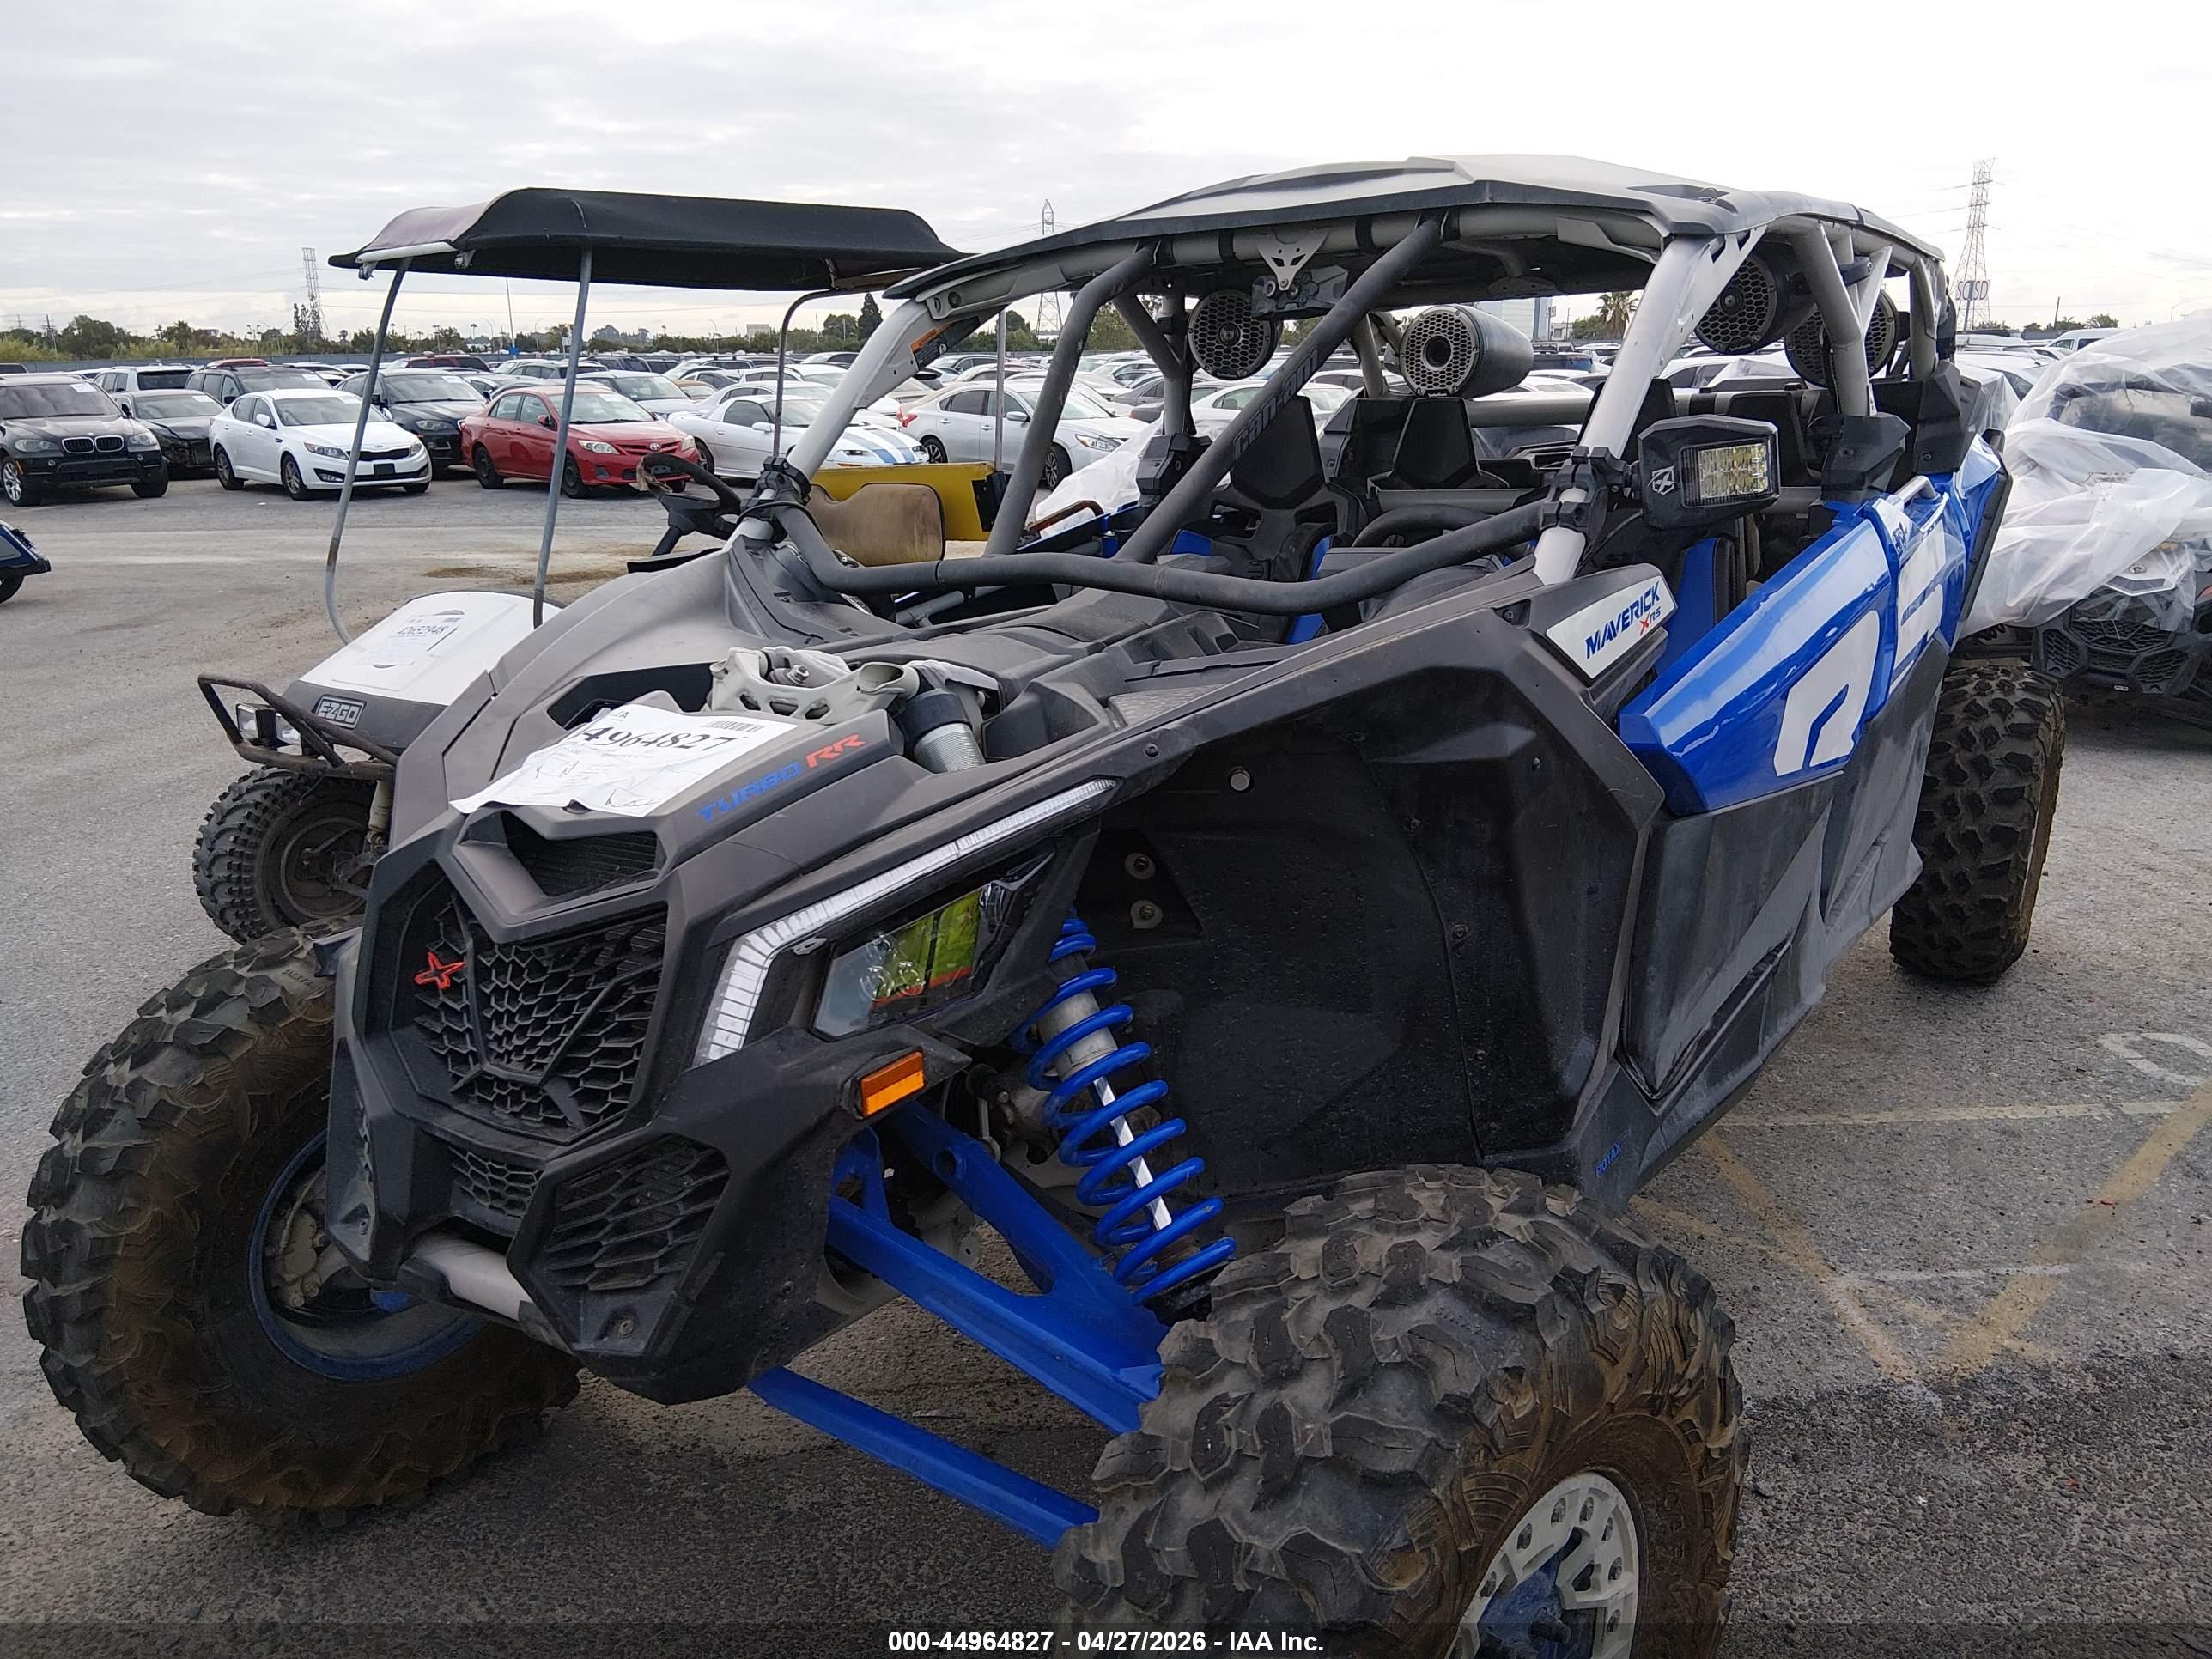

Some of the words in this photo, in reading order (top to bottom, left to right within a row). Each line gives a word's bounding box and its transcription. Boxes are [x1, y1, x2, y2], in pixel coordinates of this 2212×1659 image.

[1585, 580, 1660, 659] MAVERICK
[697, 761, 803, 824] TURBO
[805, 733, 866, 769] RR
